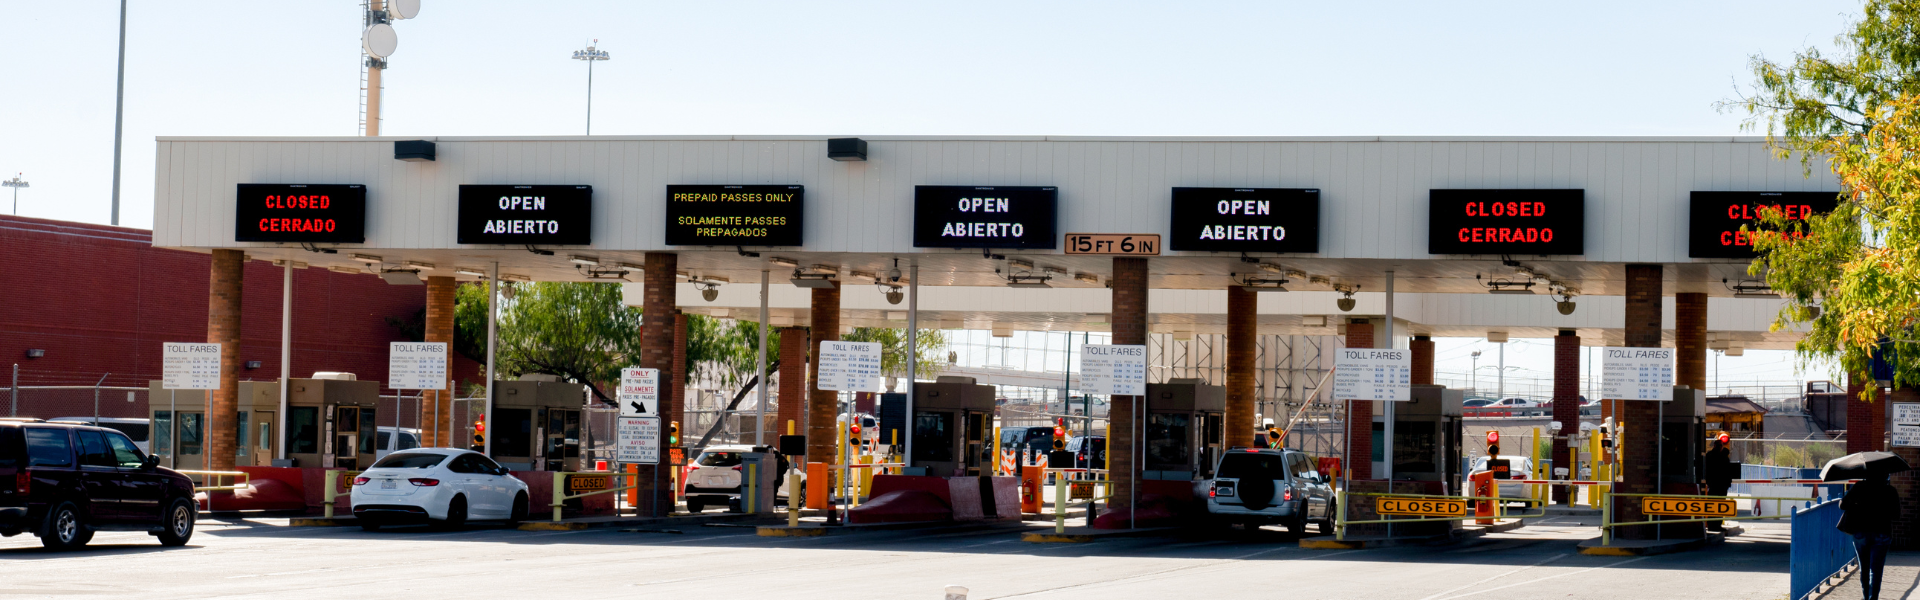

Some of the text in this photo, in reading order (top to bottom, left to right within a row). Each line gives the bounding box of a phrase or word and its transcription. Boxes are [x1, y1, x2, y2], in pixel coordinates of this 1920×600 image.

[266, 195, 330, 209] CLOSED
[499, 196, 546, 210] OPEN
[674, 193, 794, 202] PREPAID PASSES ONLY
[958, 198, 1009, 212] OPEN
[1217, 200, 1270, 215] OPEN
[1465, 201, 1546, 217] CLOSED
[259, 218, 336, 233] CERRADO
[483, 219, 559, 234] ABIERTO
[678, 216, 787, 226] SOLAMENTE PASSES
[696, 227, 768, 237] PREPAGADOS
[941, 222, 1024, 238] ABIERTO
[1199, 225, 1286, 241] ABIERTO
[1458, 227, 1553, 243] CERRADO
[1071, 236, 1153, 253] 15 FT 6 IN
[167, 345, 218, 354] TOLL FARES
[394, 344, 443, 353] TOLL FARES
[851, 344, 870, 352] FARES
[1085, 346, 1142, 357] TOLL FARES
[1608, 349, 1669, 359] TOLL FARES
[1345, 350, 1402, 360] TOLL FARES
[624, 385, 655, 393] SOLAMENTE
[573, 478, 605, 488] CLOSED
[1072, 486, 1093, 496] CLOSED
[1383, 501, 1460, 513] CLOSED
[1649, 500, 1730, 513] CLOSED
